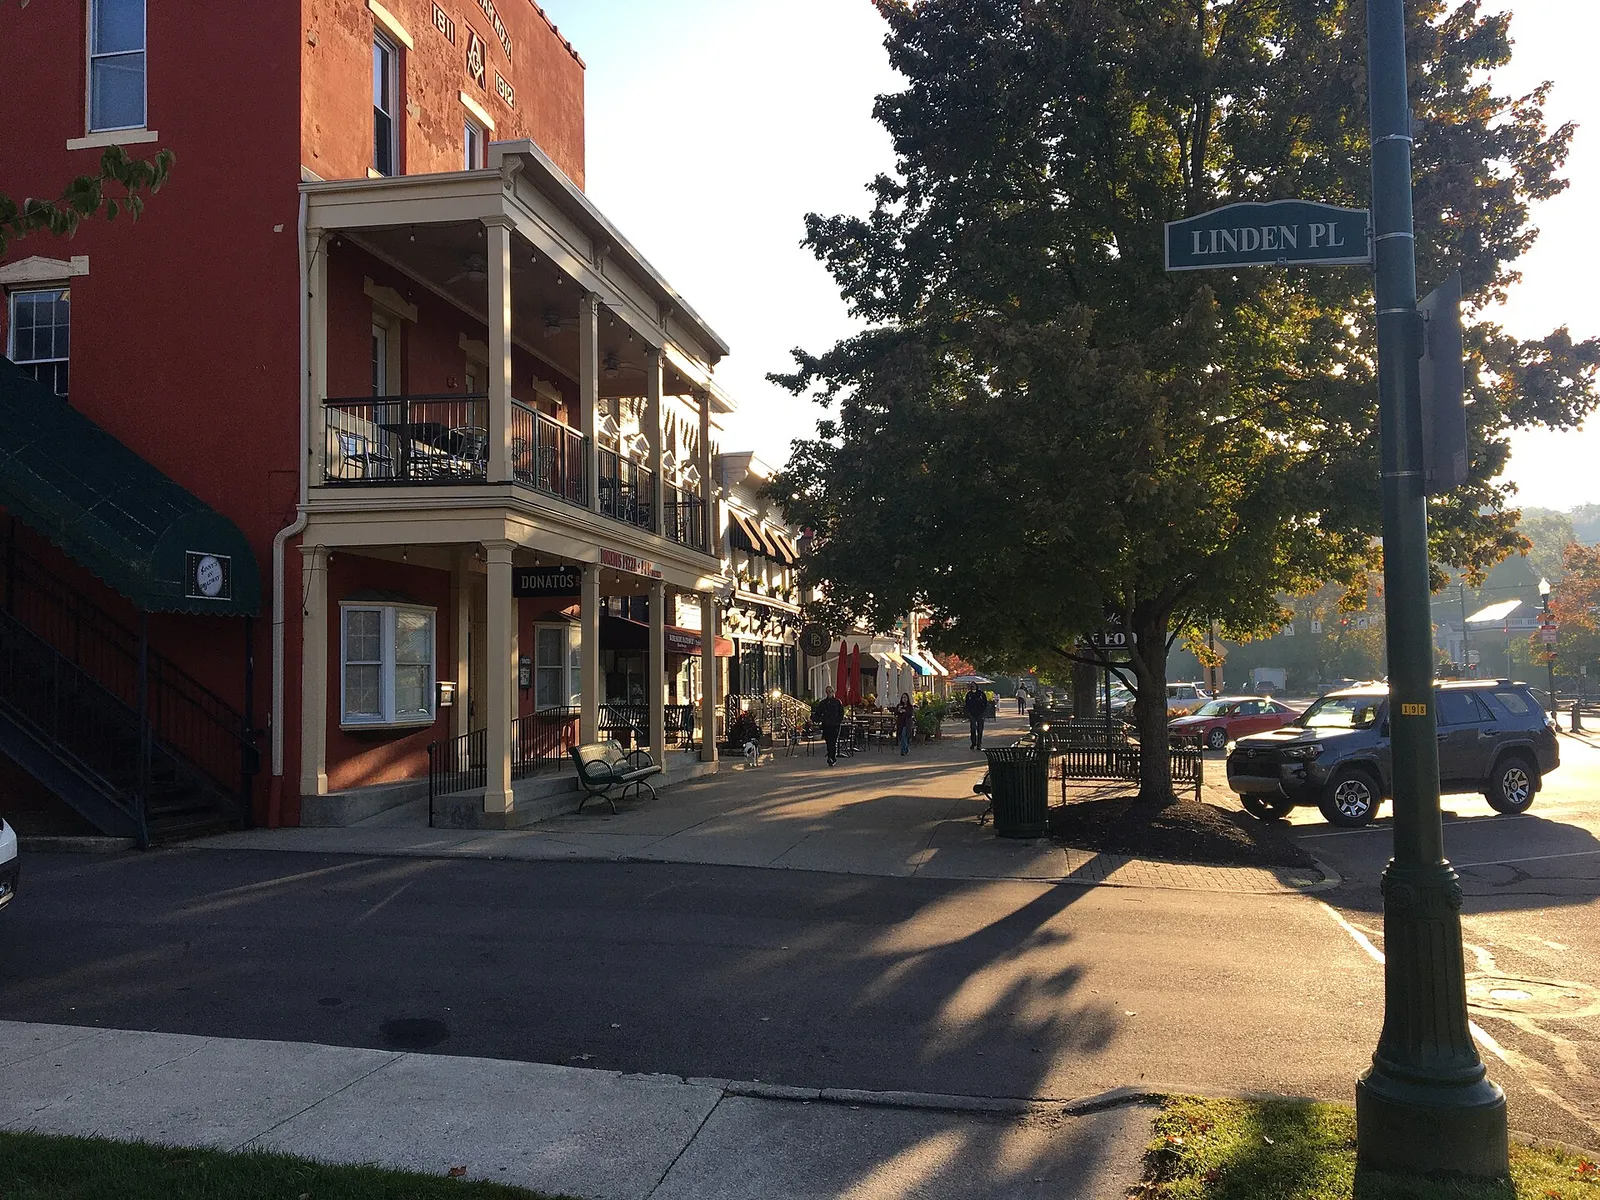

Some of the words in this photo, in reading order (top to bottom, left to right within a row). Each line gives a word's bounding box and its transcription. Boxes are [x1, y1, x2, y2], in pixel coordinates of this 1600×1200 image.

[432, 4, 455, 44] 1811
[495, 72, 514, 108] 1912
[1191, 224, 1299, 255] LINDEN
[1309, 222, 1345, 248] PL
[521, 575, 575, 589] DONATOS
[1403, 705, 1424, 714] 198
